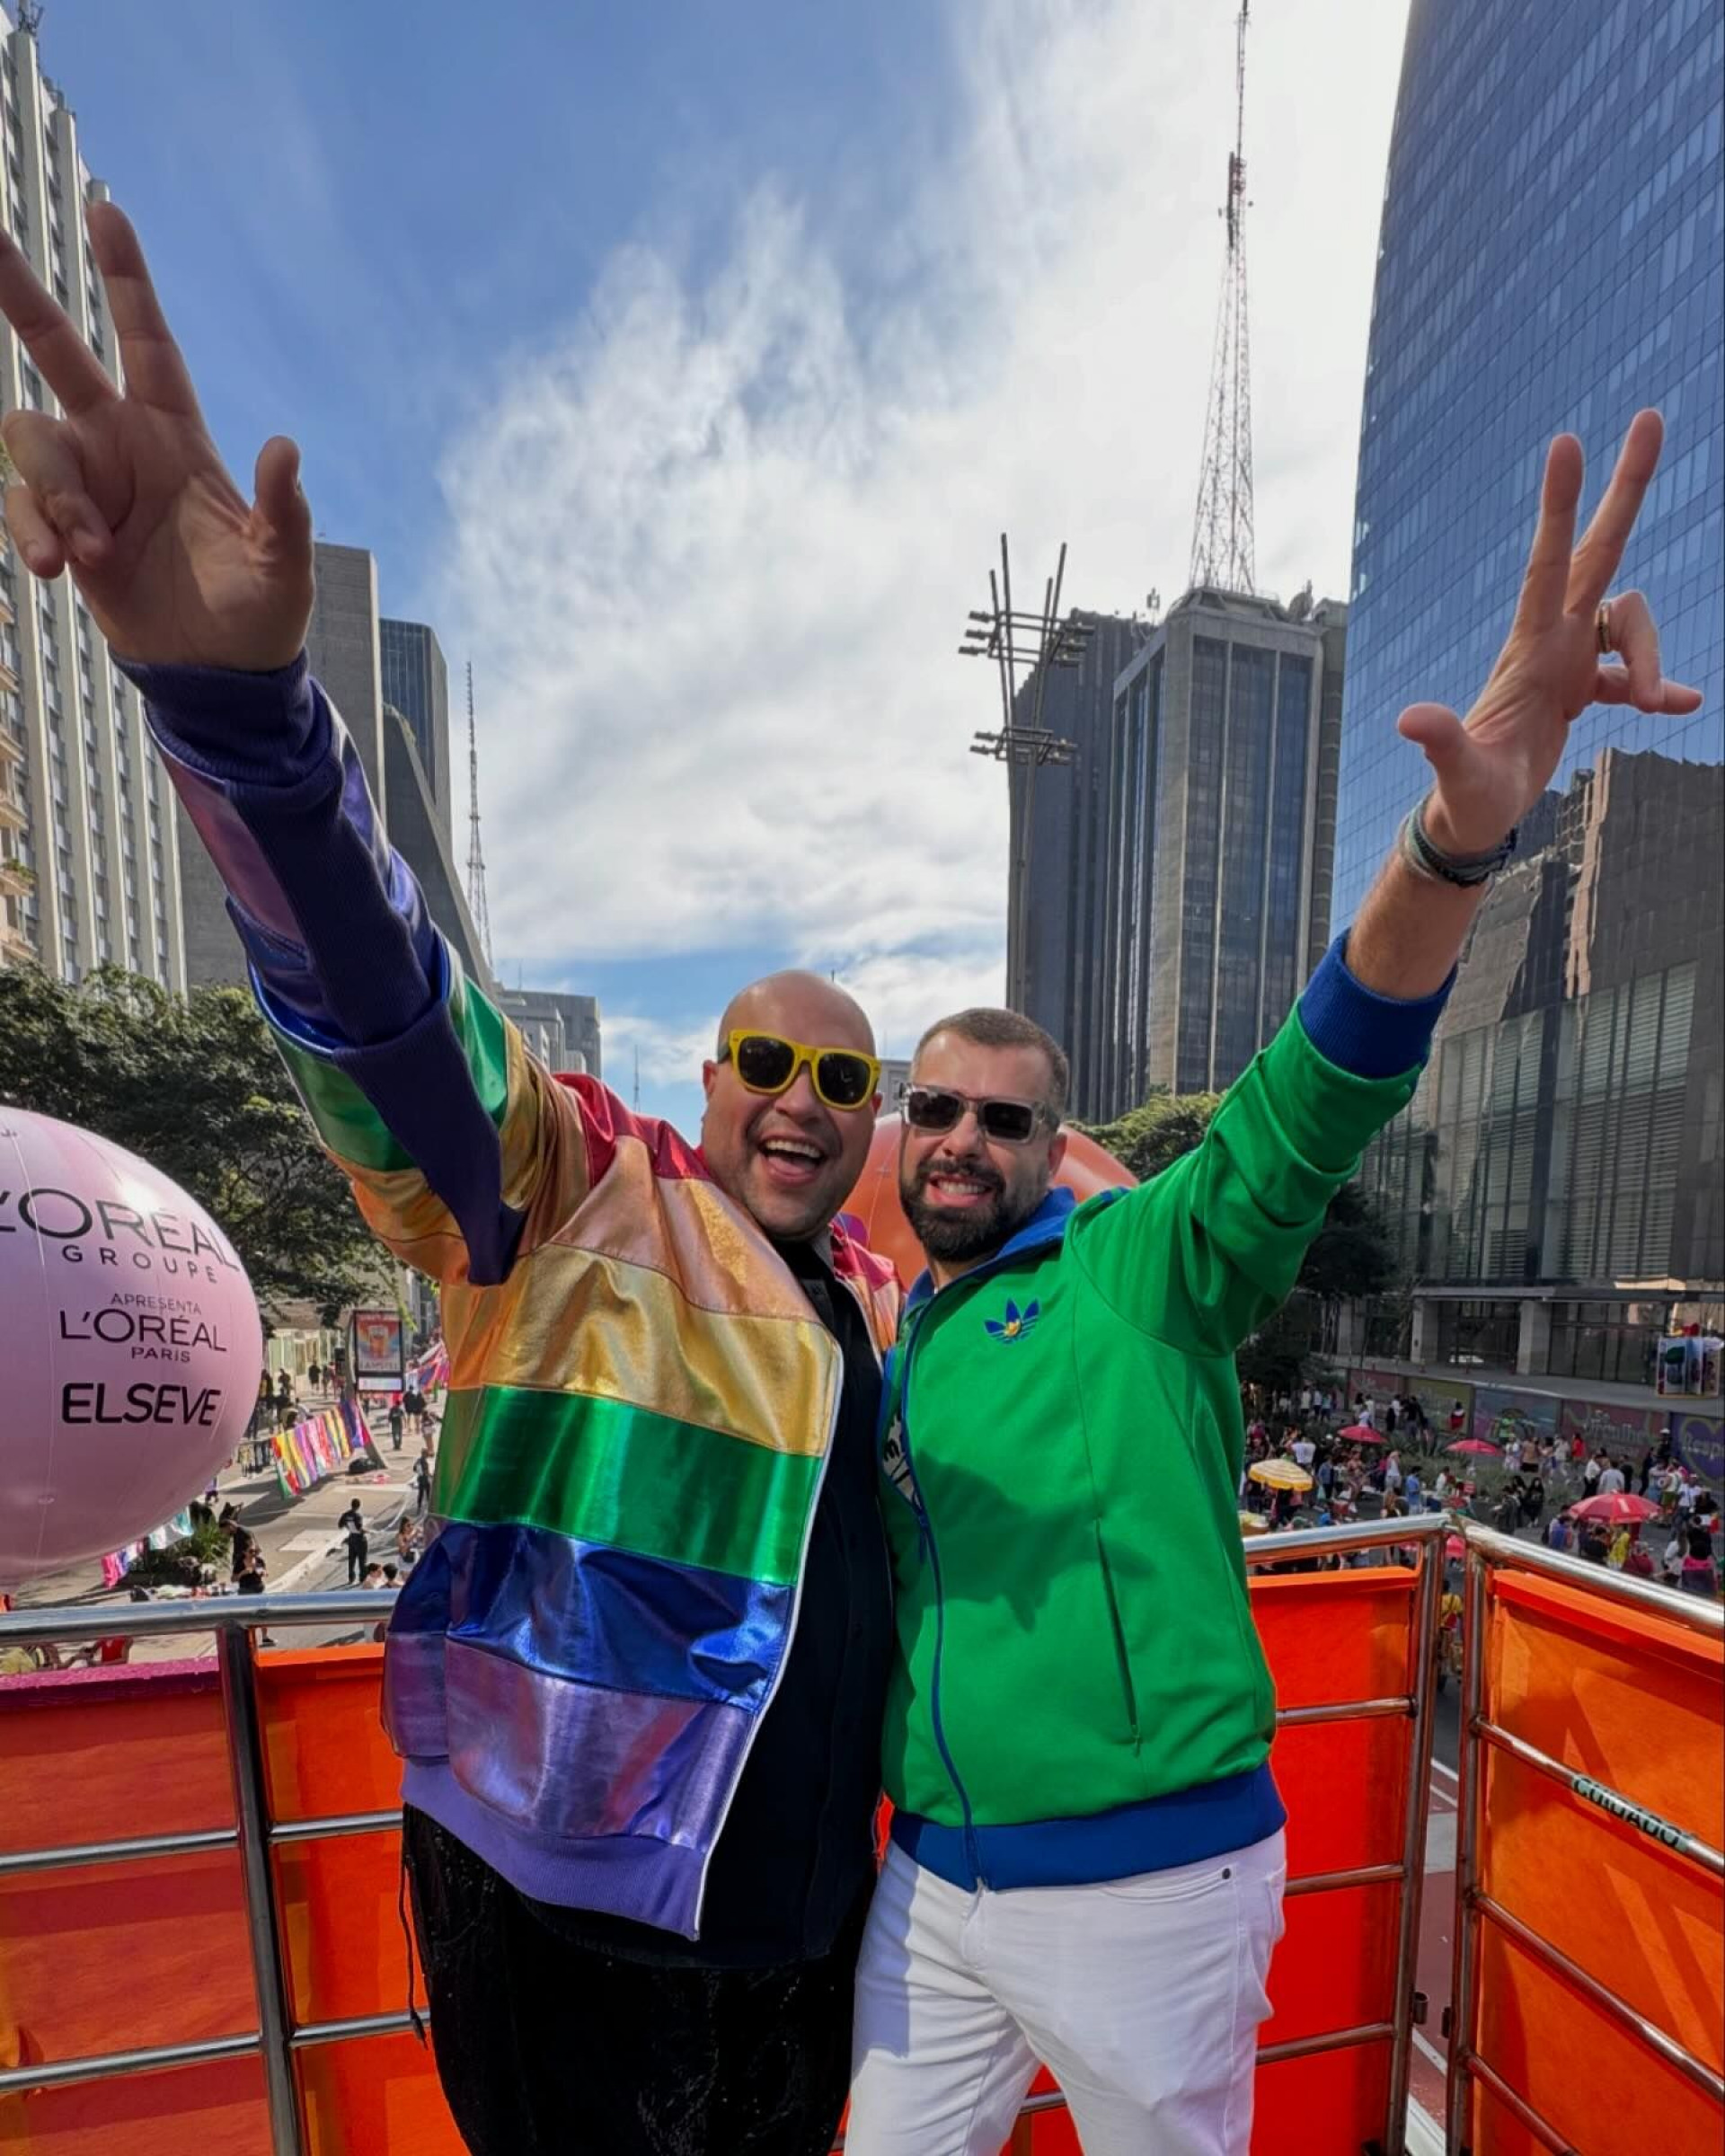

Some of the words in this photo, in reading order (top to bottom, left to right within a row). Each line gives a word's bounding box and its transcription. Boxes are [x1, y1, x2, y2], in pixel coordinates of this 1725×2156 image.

[0, 1188, 240, 1271] 'ORÉAL
[61, 1244, 217, 1284] GROUPE
[111, 1293, 202, 1315] APRESENTA
[59, 1308, 227, 1352] L'ORÉAL
[131, 1347, 191, 1363] PARIS
[62, 1383, 222, 1427] ELSEVE
